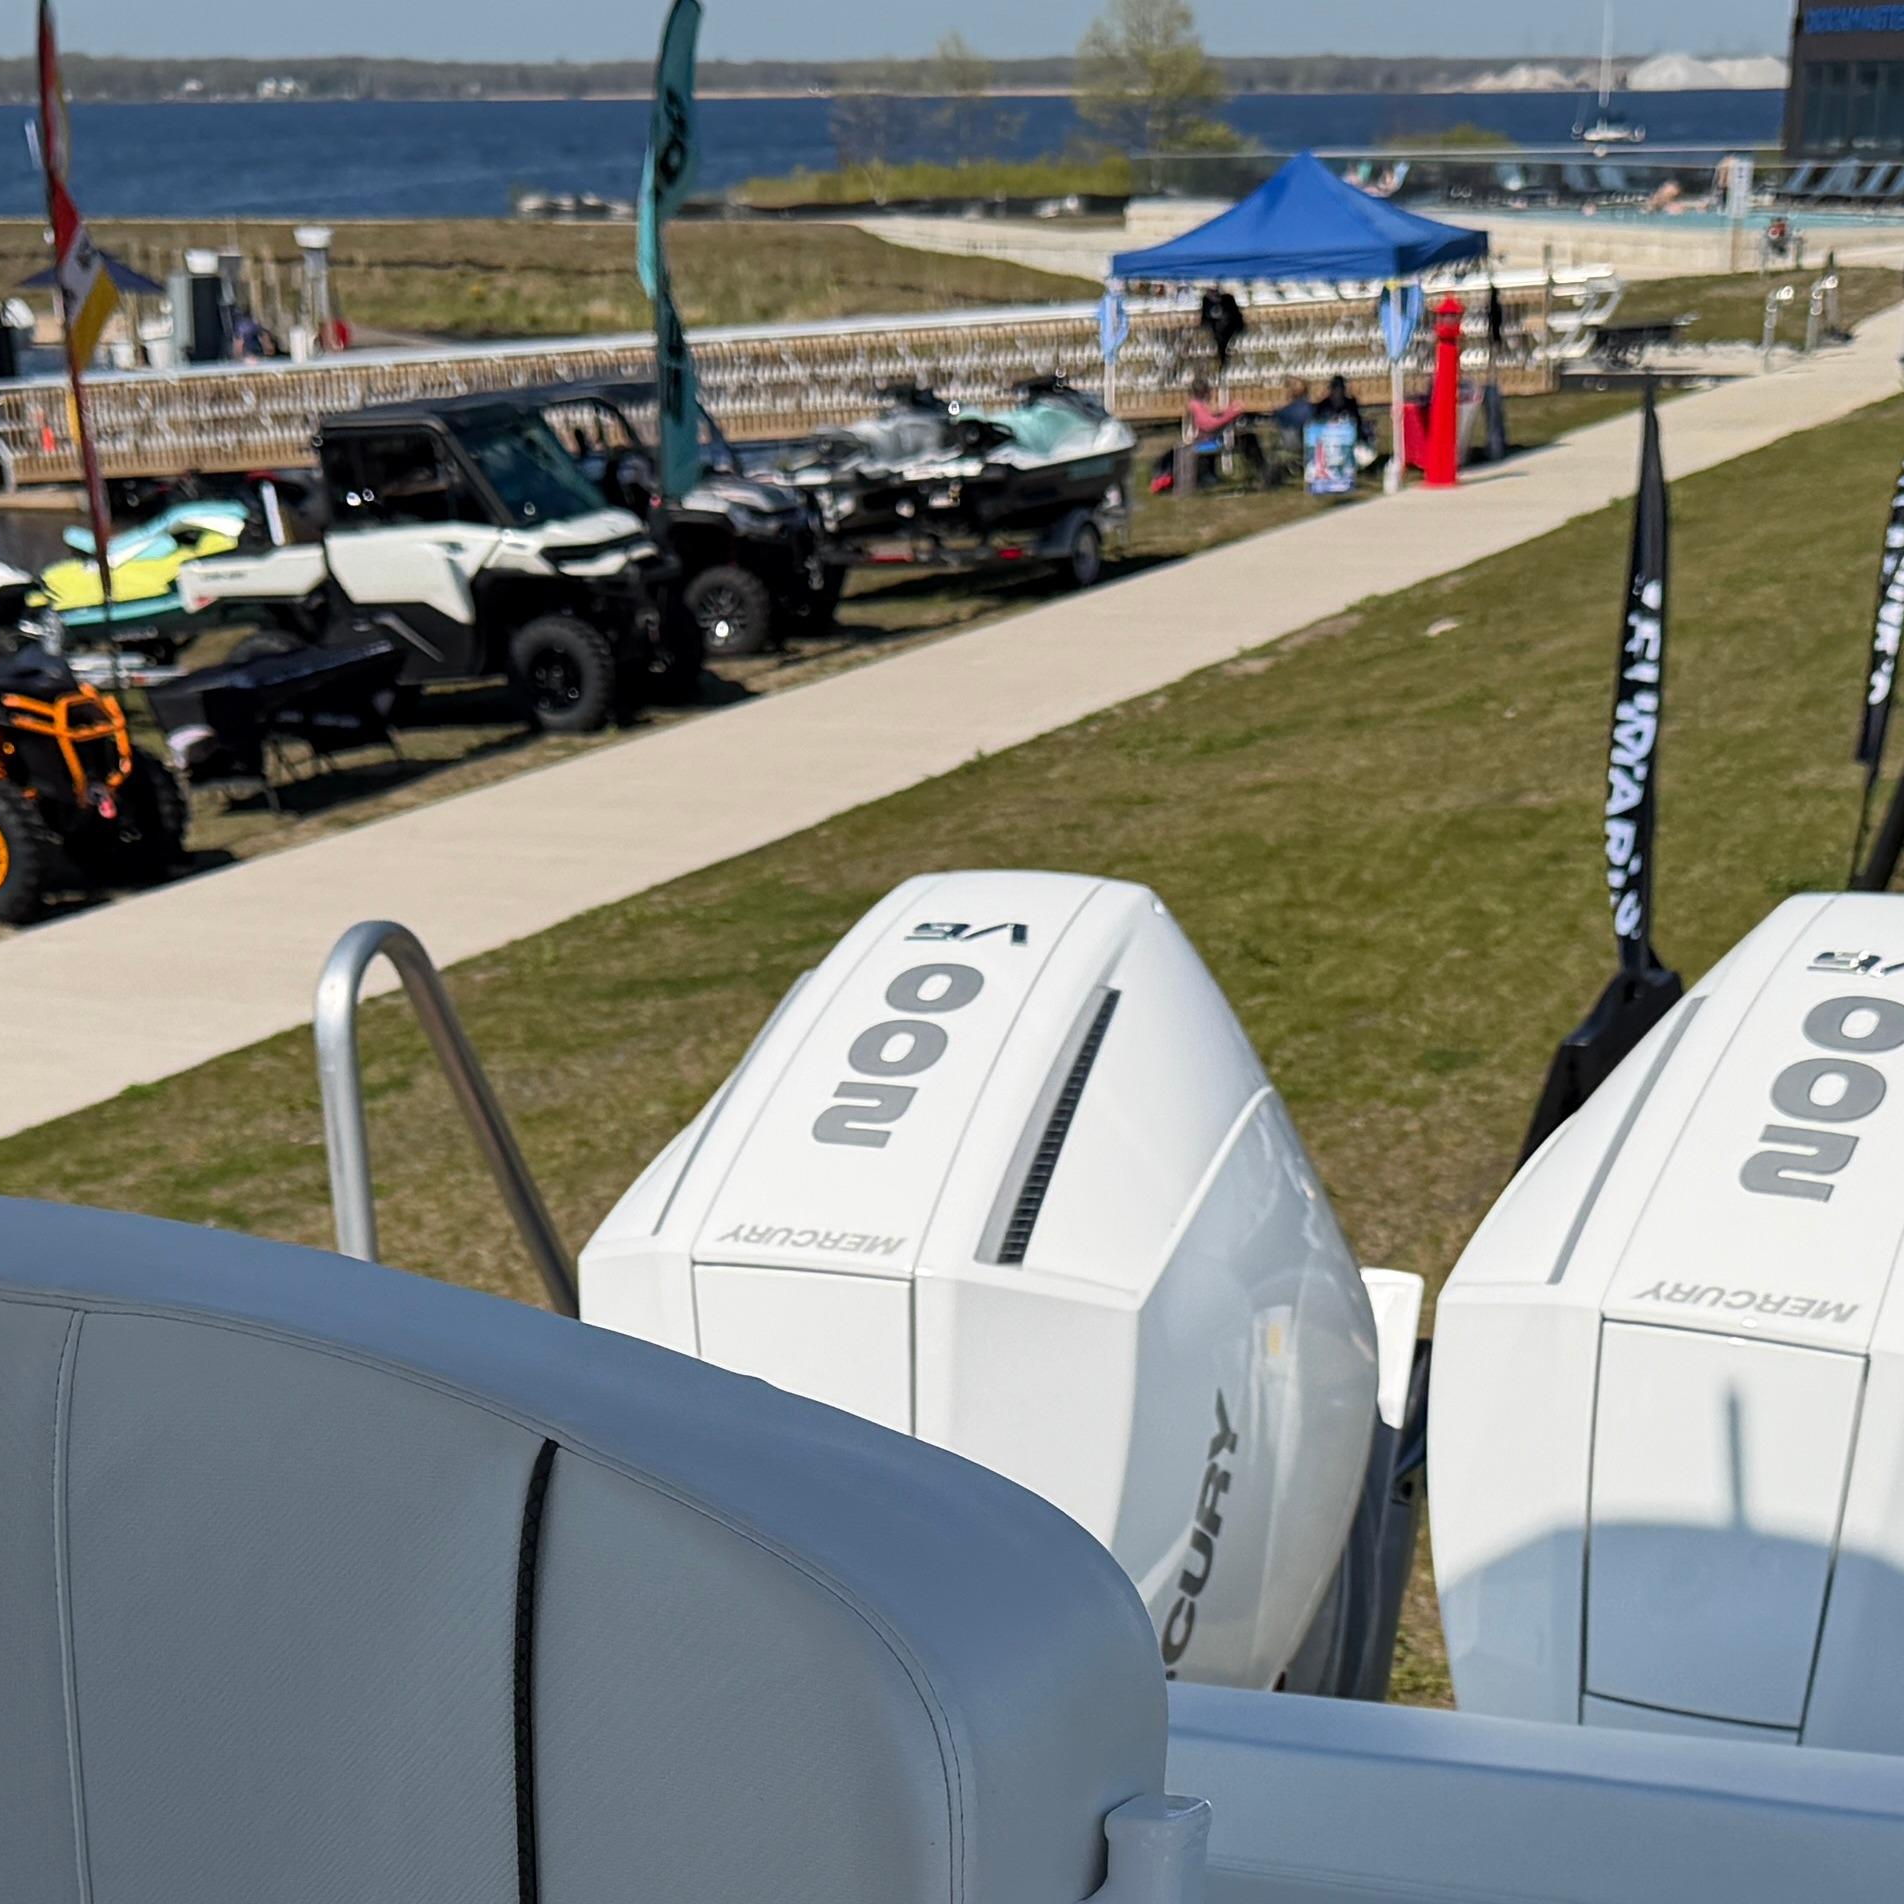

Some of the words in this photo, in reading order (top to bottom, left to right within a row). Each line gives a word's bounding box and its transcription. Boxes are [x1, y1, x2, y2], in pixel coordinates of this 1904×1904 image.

[904, 922, 1028, 946] V6
[812, 962, 985, 1149] 200
[715, 1223, 909, 1256] MERCURY
[1631, 1280, 1860, 1323] MERCURY
[1161, 1386, 1238, 1681] CURY
